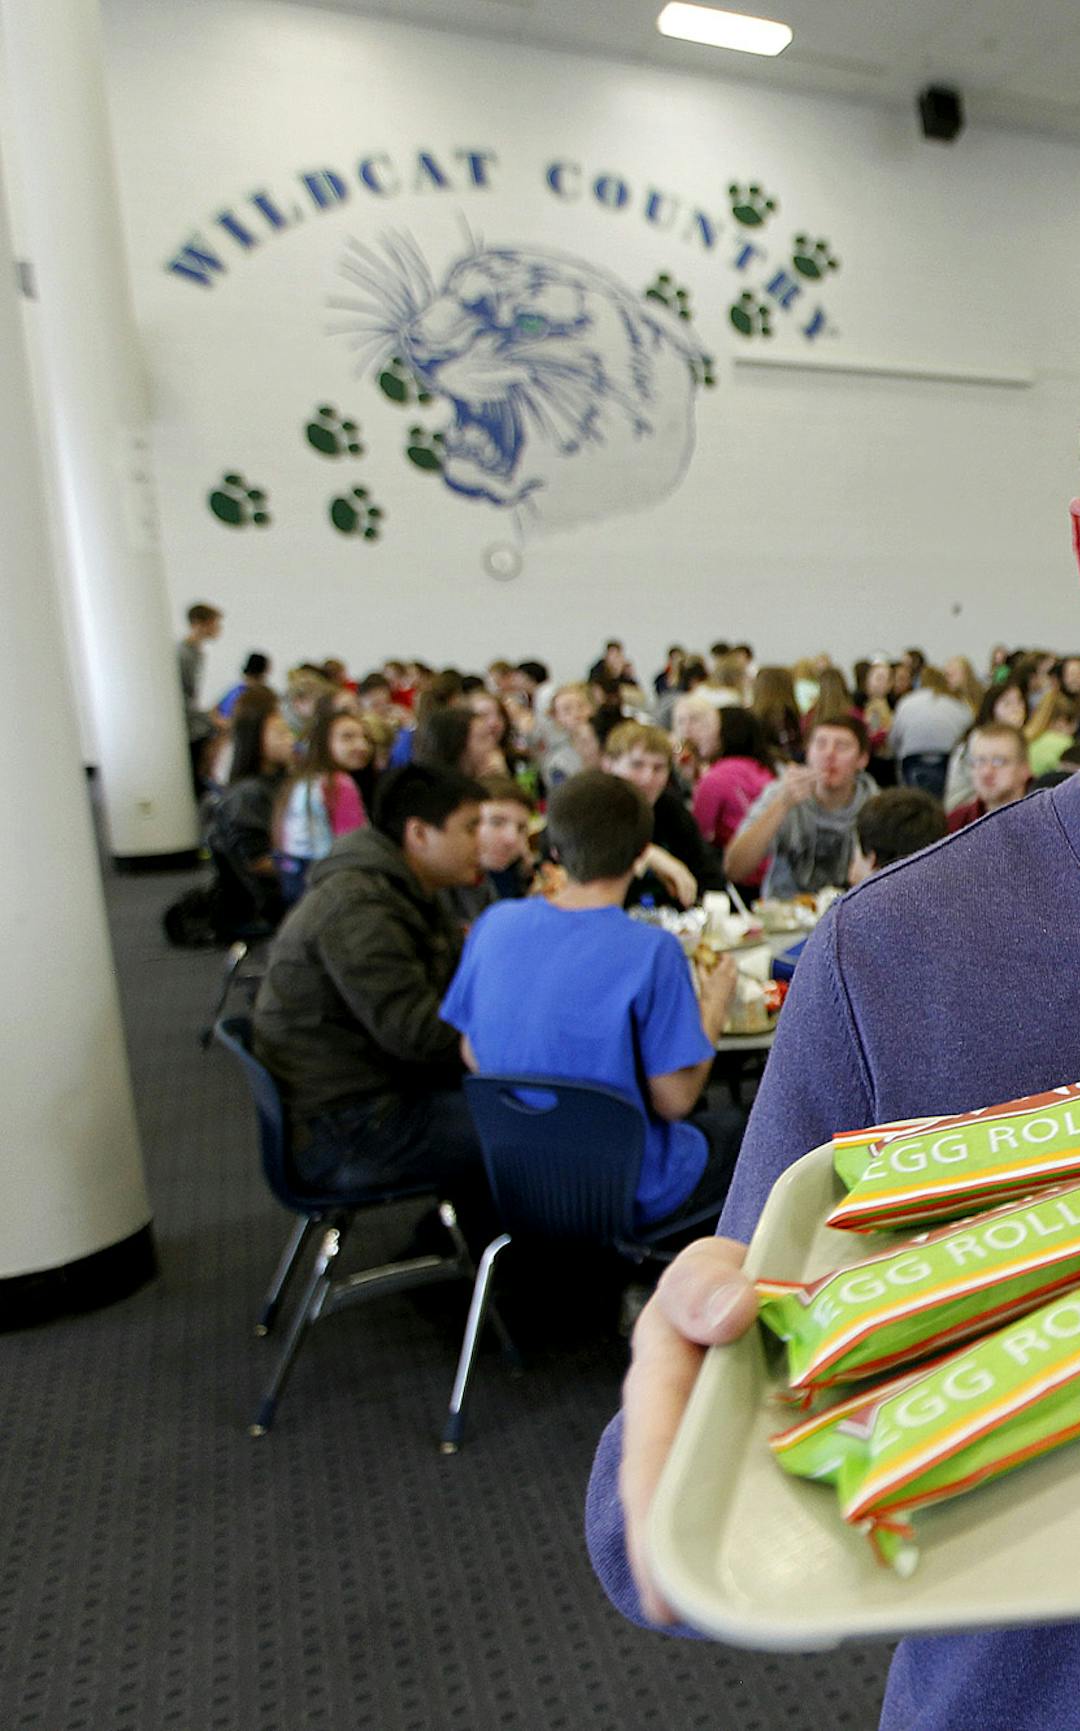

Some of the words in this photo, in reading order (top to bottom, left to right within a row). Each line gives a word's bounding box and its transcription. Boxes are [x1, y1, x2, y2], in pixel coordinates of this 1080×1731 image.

[165, 149, 498, 290] WILDCAT
[545, 159, 836, 344] COUNTRY
[861, 1133, 970, 1182] EGG
[812, 1255, 933, 1330] EGG
